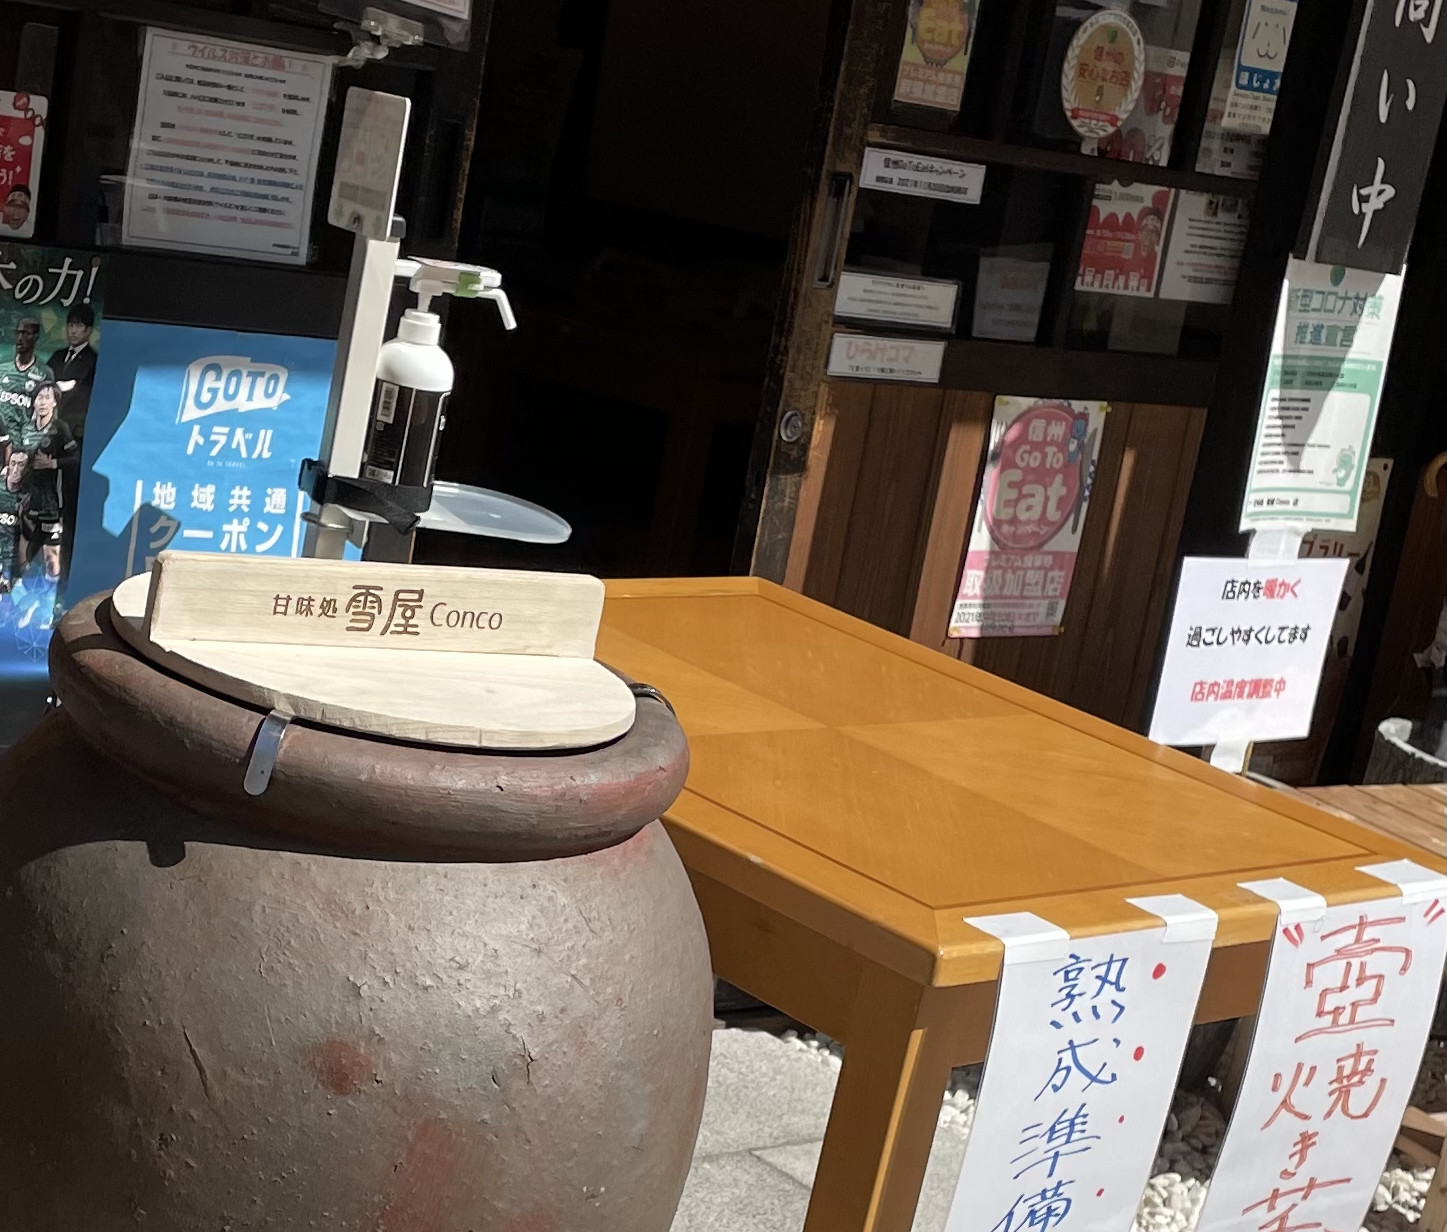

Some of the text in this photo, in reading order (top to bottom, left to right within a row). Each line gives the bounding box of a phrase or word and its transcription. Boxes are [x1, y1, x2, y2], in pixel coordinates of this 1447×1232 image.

[187, 426, 275, 461] トラベル
[1028, 417, 1067, 443] 信州
[152, 482, 288, 517] 地域共通
[994, 467, 1068, 522] Eat
[149, 517, 285, 556] クーポン
[1220, 578, 1302, 601] 店内を暖かく
[271, 593, 338, 618] 甘味処
[429, 602, 504, 631] Conco
[1185, 623, 1312, 648] 過ごしやすくしてます
[1190, 676, 1287, 703] 店内温度調整中
